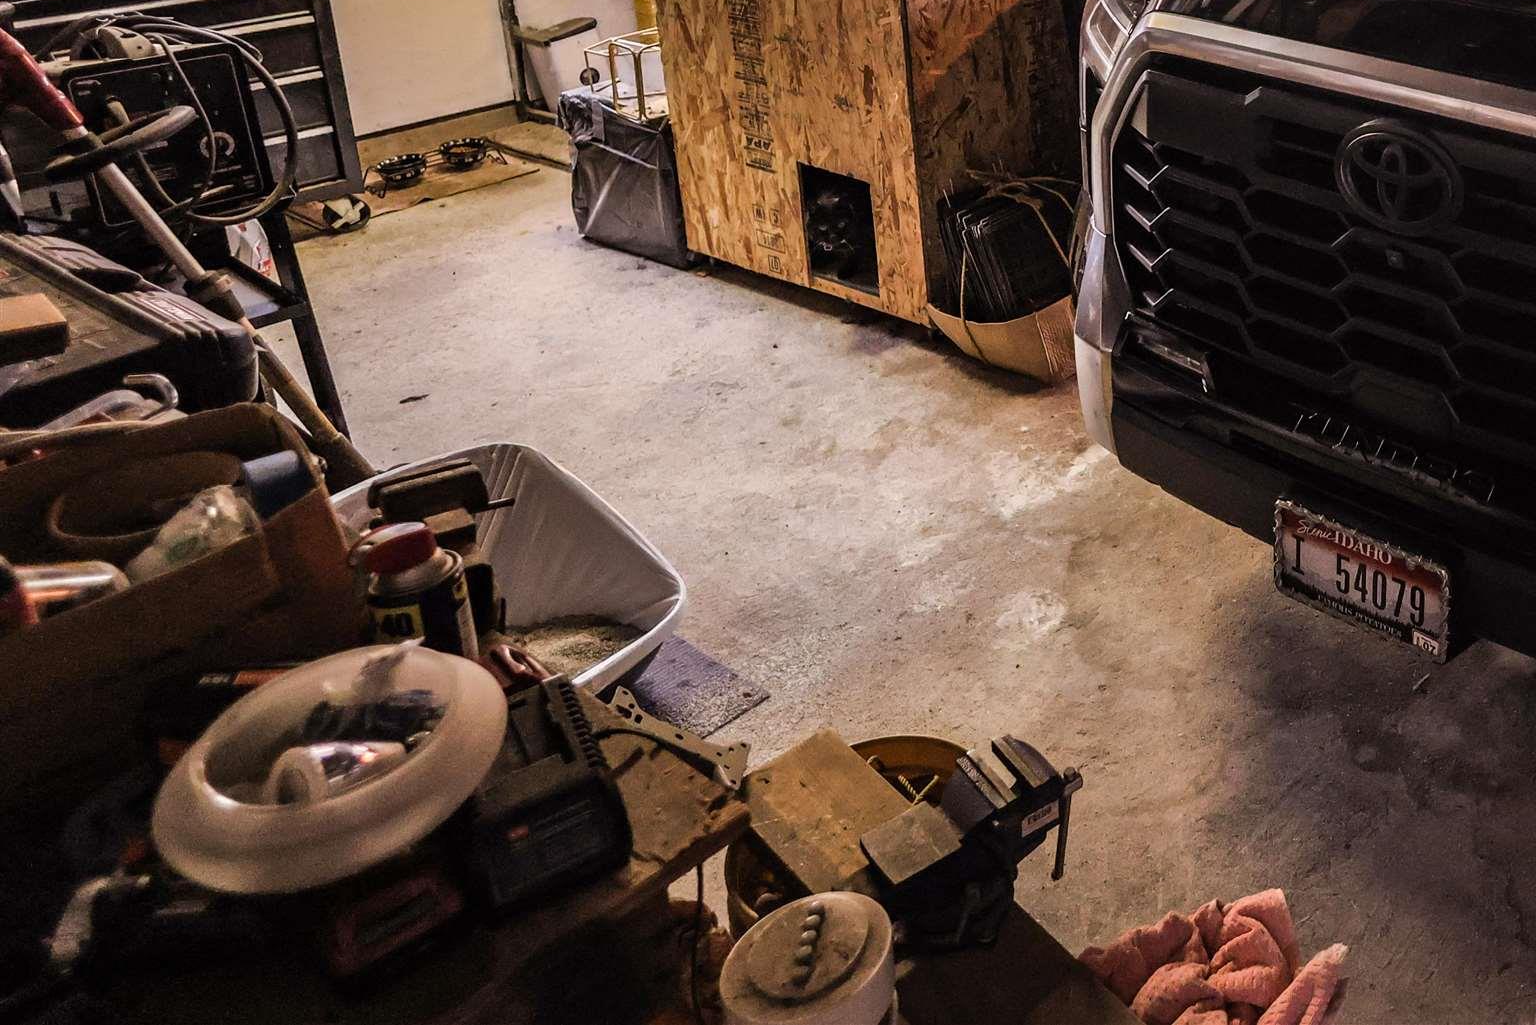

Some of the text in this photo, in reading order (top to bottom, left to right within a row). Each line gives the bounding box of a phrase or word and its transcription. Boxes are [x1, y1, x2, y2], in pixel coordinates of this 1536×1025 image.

[1296, 519, 1393, 565] Scenic IDAHO
[1335, 552, 1425, 627] 54079
